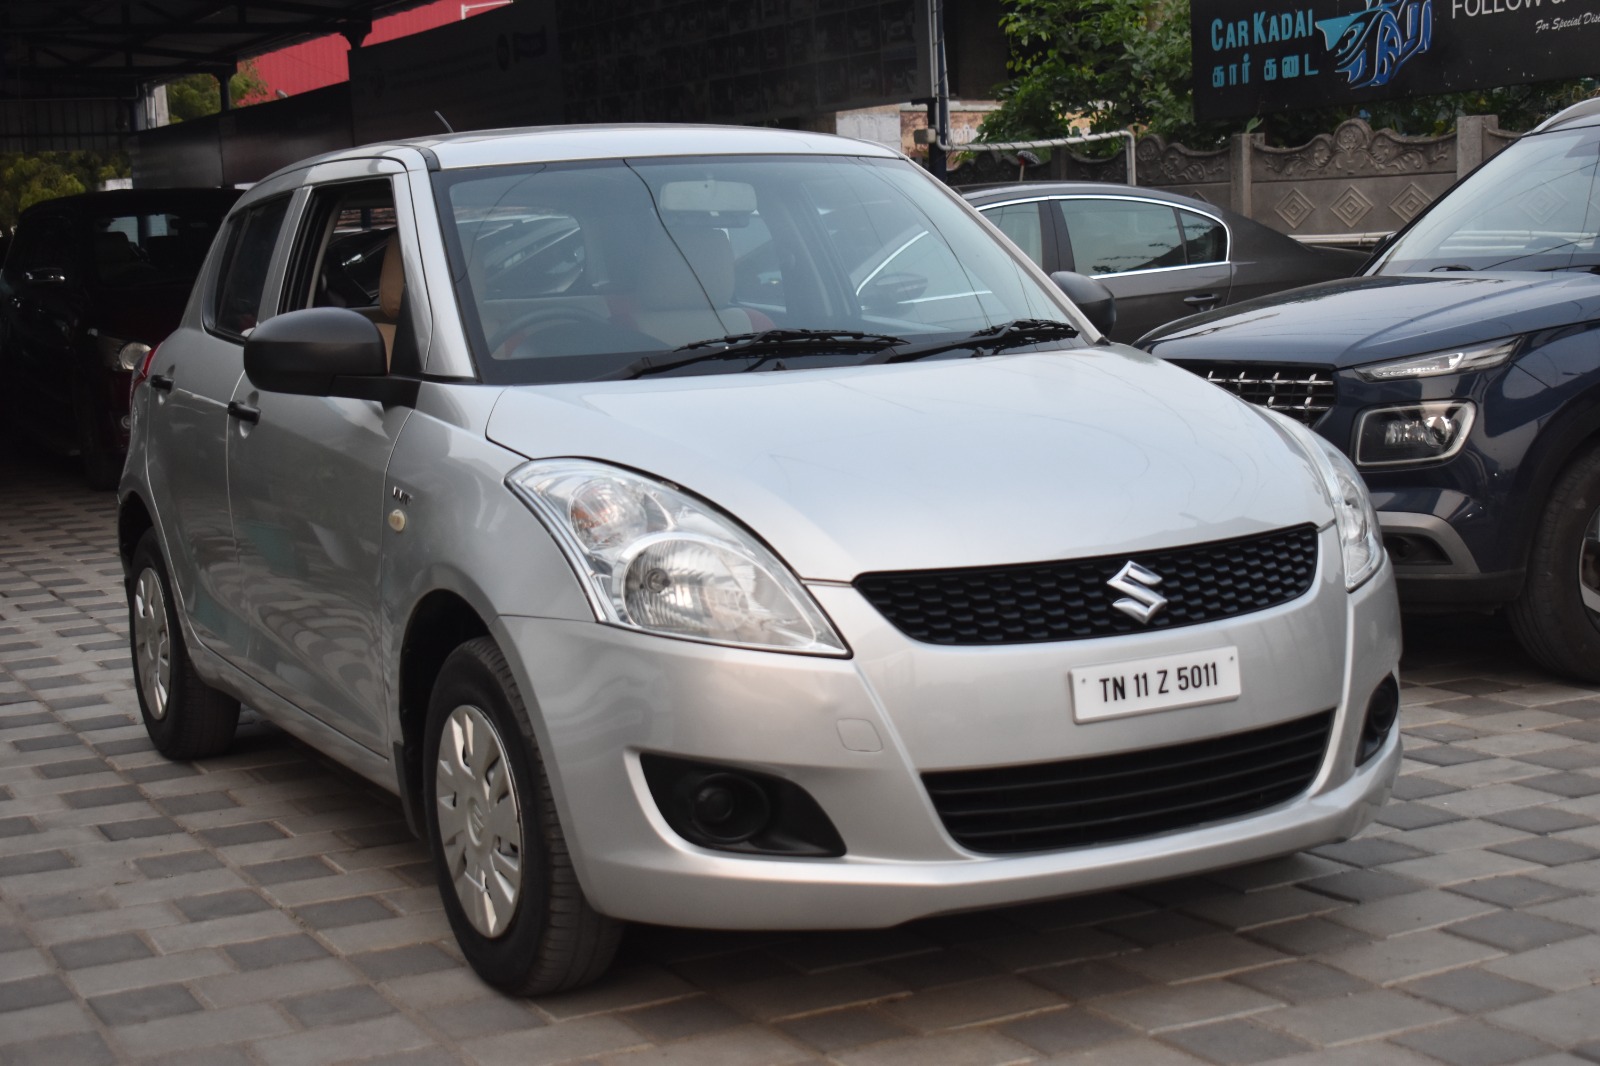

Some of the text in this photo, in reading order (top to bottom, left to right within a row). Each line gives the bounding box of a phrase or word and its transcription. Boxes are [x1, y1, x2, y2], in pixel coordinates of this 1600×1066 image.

[1211, 8, 1313, 51] CAR KADAI
[1535, 19, 1549, 33] For
[1551, 14, 1582, 31] Special
[1212, 53, 1319, 88] கார் கடை
[1099, 661, 1218, 702] TN 11 Z 5011
